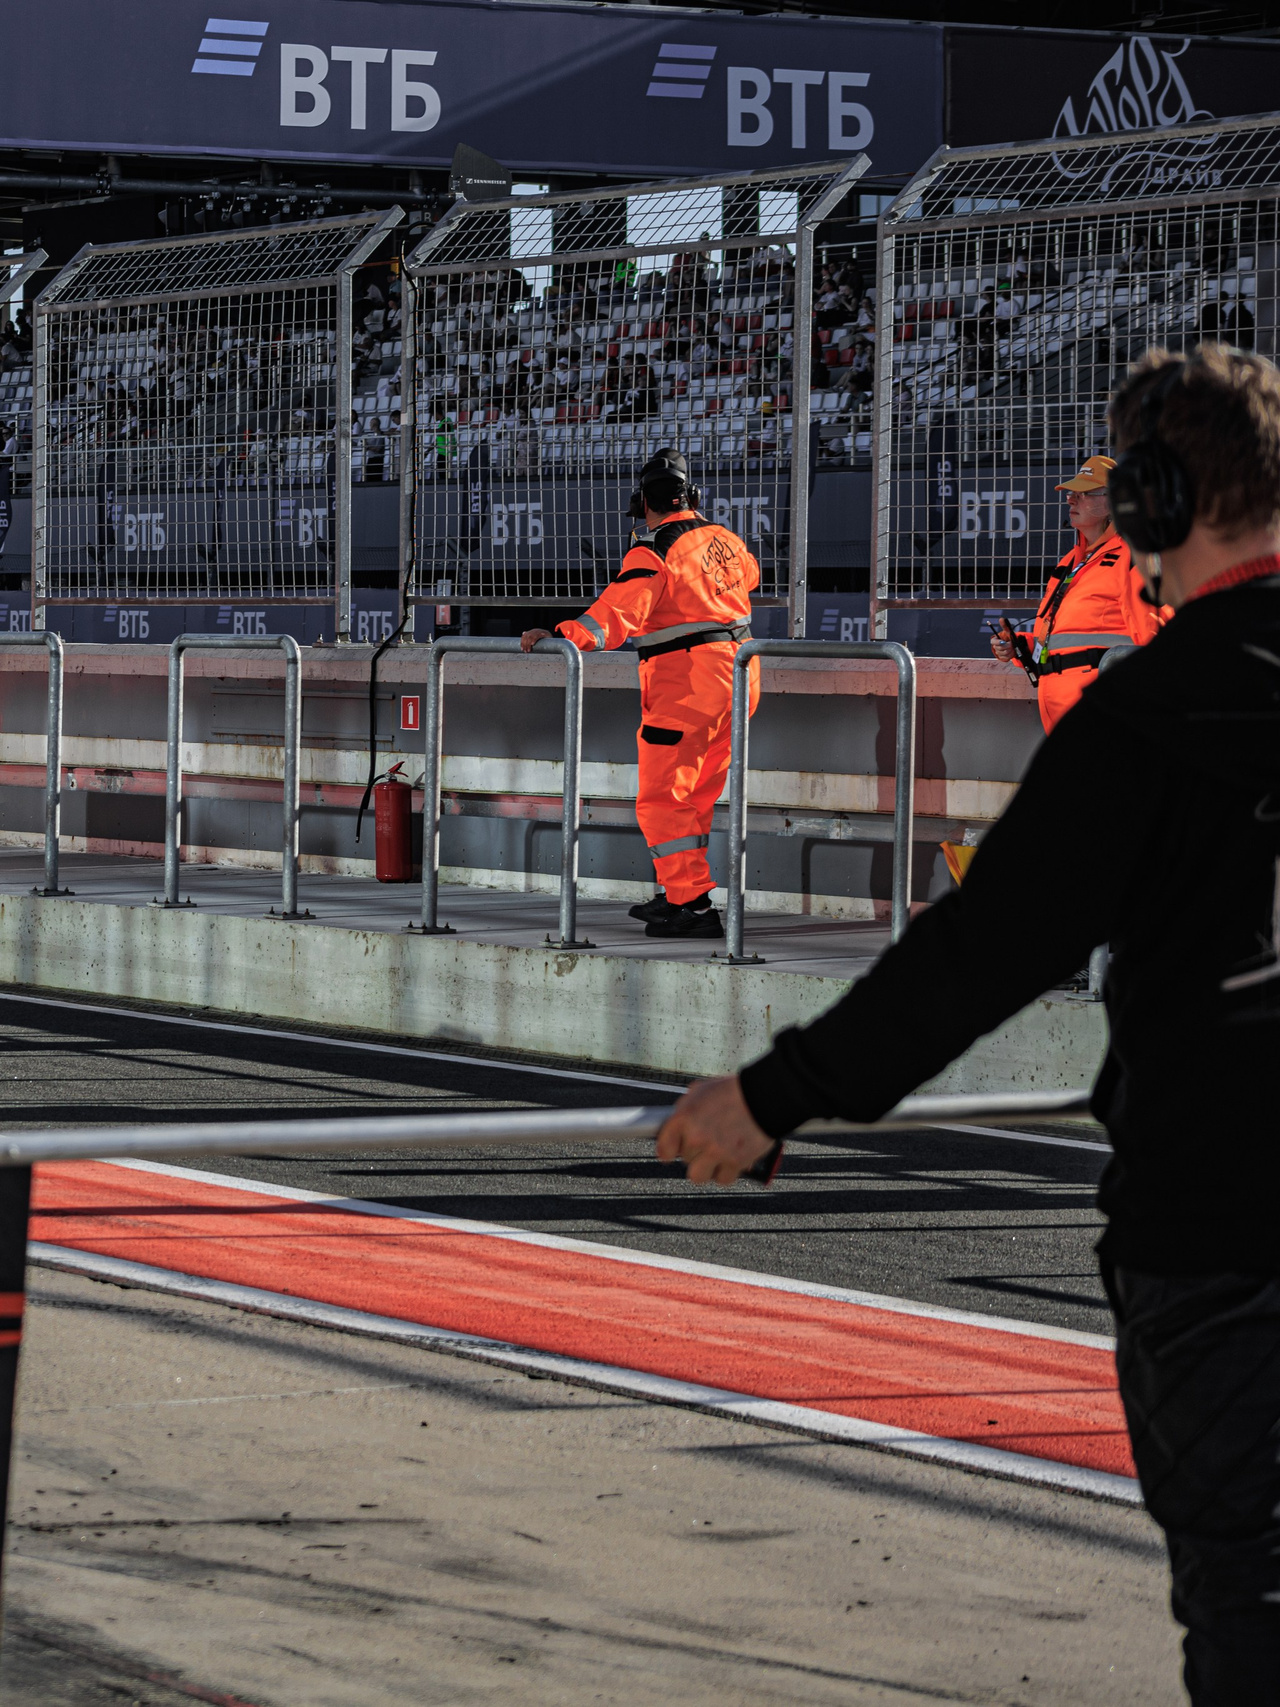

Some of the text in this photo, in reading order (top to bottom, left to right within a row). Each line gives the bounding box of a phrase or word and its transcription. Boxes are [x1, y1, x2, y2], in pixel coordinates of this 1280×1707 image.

[279, 43, 442, 133] ВТБ
[727, 66, 874, 151] ВТБ
[1152, 164, 1222, 186] ДРАЙВ
[123, 512, 166, 552] ВТБ
[298, 507, 328, 548] ВТ
[491, 502, 543, 546] ВТБ
[961, 490, 1027, 540] ВТБ
[9, 610, 32, 632] ВТ
[118, 610, 150, 639] ВТБ
[232, 611, 266, 635] ВТБ
[357, 610, 393, 641] ВТБ
[840, 617, 870, 642] ВТ
